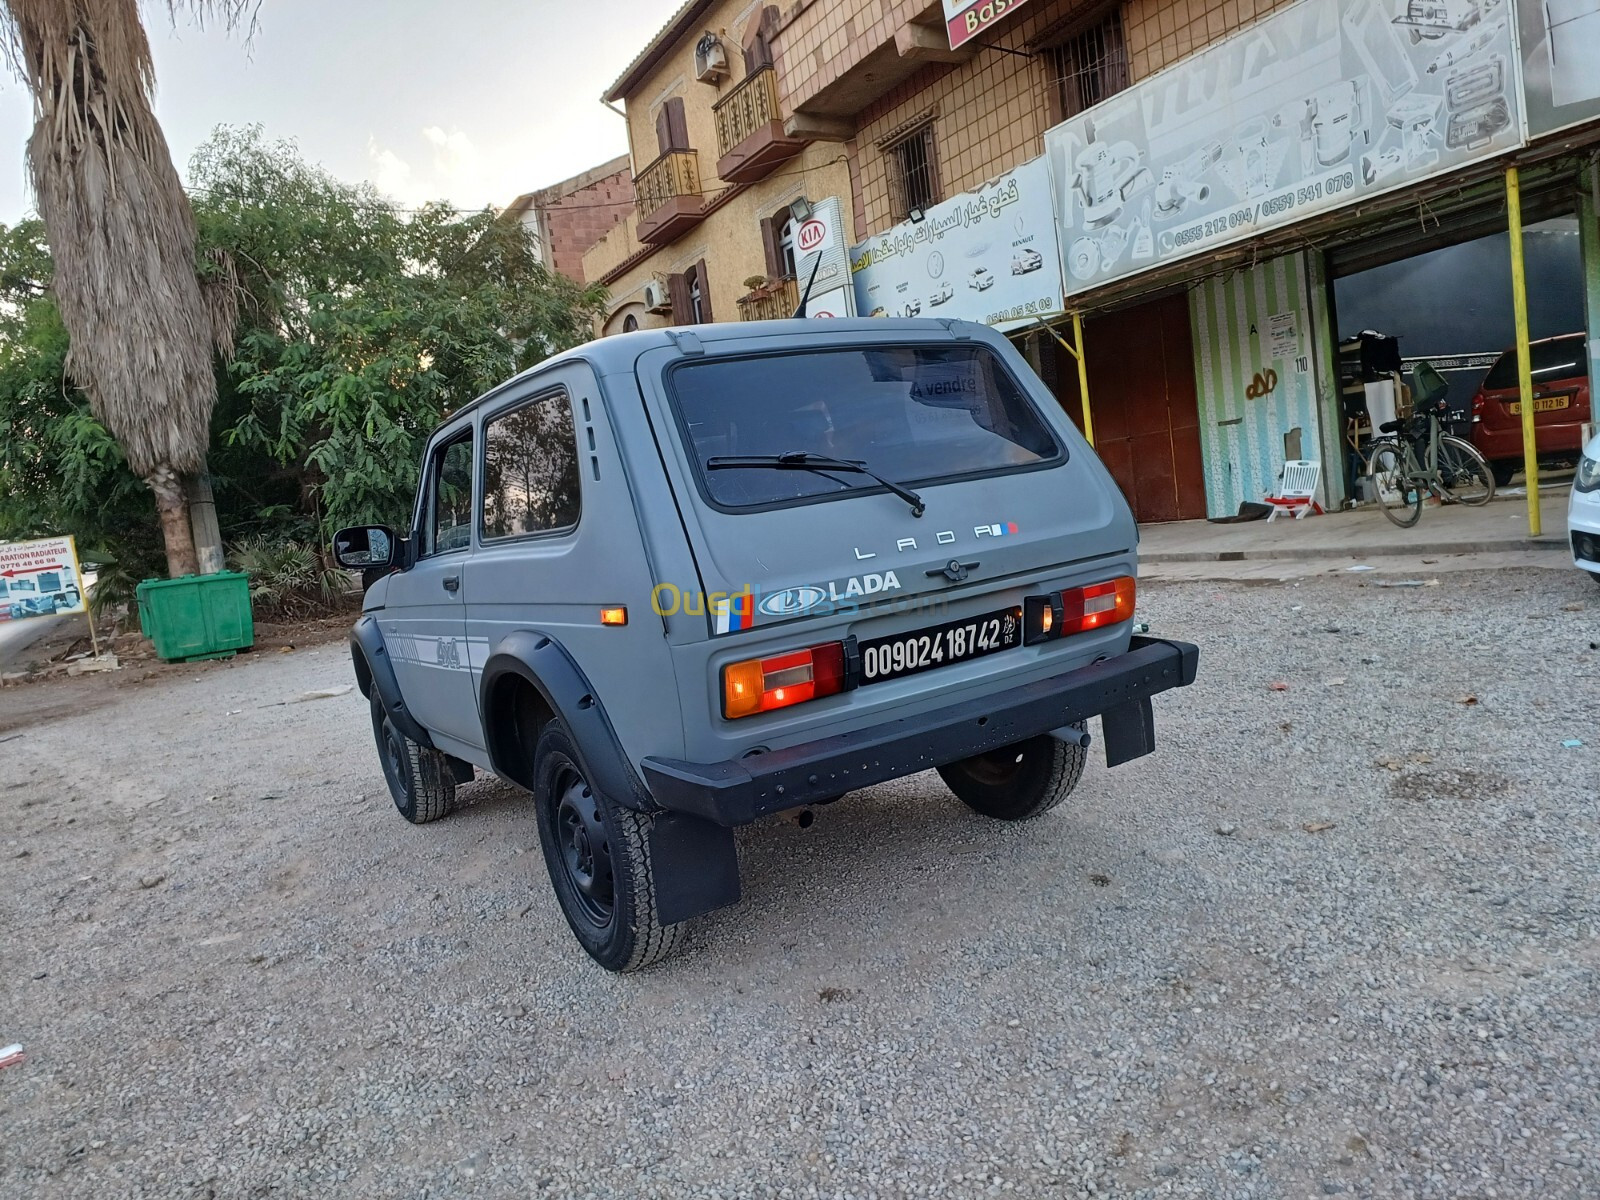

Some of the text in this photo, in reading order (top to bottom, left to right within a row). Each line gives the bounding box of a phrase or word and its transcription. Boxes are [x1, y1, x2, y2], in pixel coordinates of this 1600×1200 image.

[965, 0, 1015, 34] Bas
[964, 196, 988, 228] غيار
[989, 179, 1019, 218] قطع
[1175, 226, 1203, 247] 0555
[1205, 217, 1227, 237] 212
[1229, 207, 1252, 228] 094
[1262, 193, 1294, 217] 0559
[1297, 183, 1322, 204] 541
[1325, 172, 1353, 195] 078
[801, 225, 821, 246] KIA
[915, 206, 962, 244] السيارات
[1012, 235, 1034, 248] RENAULT
[1250, 324, 1258, 335] A
[1296, 356, 1308, 373] 110
[926, 376, 976, 395] vendre
[31, 547, 68, 558] RADIATEUR
[854, 525, 993, 560] LADA
[829, 571, 901, 602] LADA
[864, 632, 944, 678] 009024
[946, 619, 1000, 660] 18742
[1004, 634, 1014, 644] DZ
